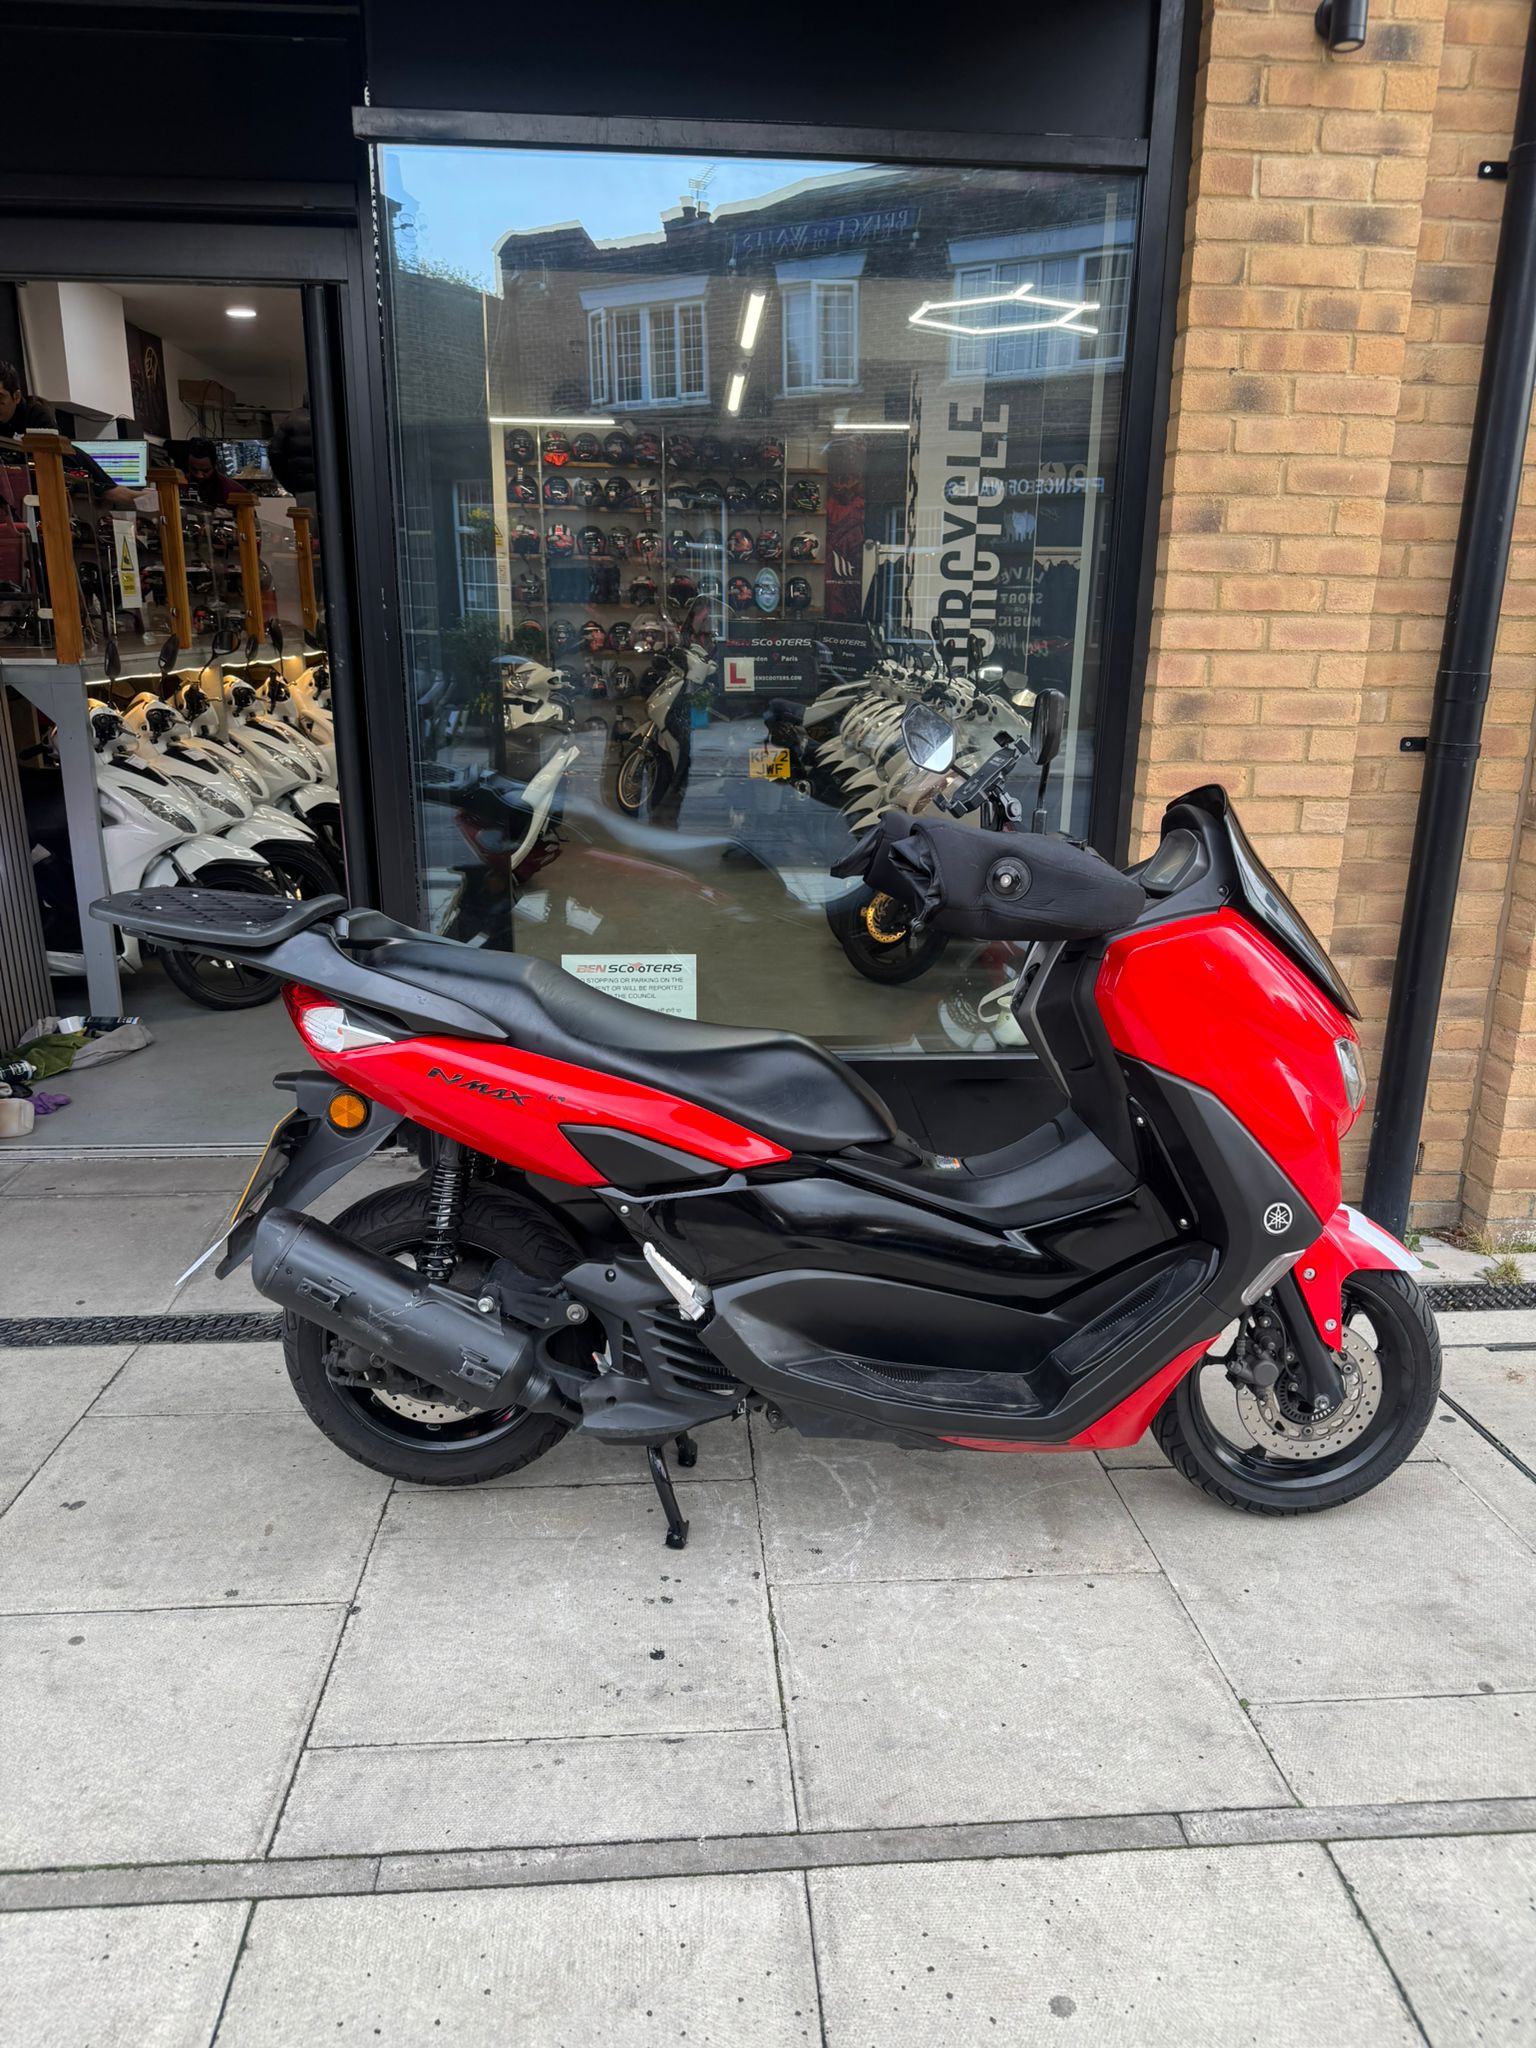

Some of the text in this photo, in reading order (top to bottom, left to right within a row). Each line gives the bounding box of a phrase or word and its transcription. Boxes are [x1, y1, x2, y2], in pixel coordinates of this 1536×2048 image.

[938, 402, 1010, 660] ORCYCLE
[729, 662, 747, 685] L
[756, 763, 784, 775] JWF
[576, 964, 607, 974] BEN
[427, 1067, 532, 1106] NMAX
